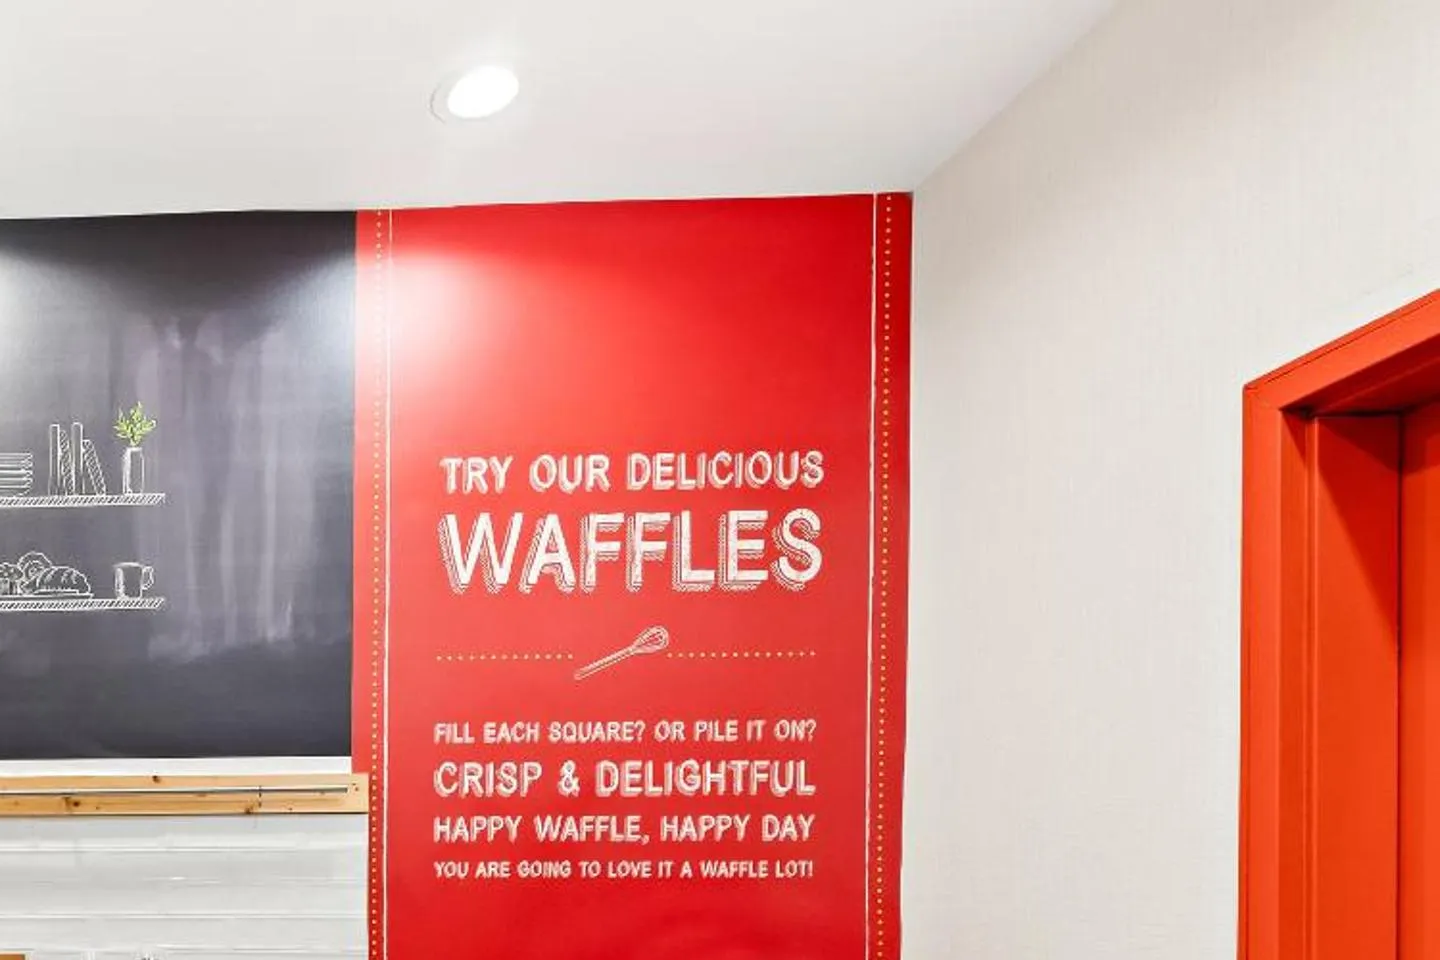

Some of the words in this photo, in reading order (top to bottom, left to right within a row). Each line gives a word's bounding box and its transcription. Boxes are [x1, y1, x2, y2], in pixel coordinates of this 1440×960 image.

[440, 455, 514, 495] TRY
[529, 453, 611, 494] OUR
[627, 449, 825, 490] DELICIOUS
[437, 508, 823, 593] WAFFLES
[434, 722, 475, 744] FILL
[483, 721, 539, 744] EACH
[548, 721, 646, 743] SQUARE?
[654, 720, 685, 741] OR
[693, 720, 738, 742] PILE
[746, 719, 764, 740] IT
[774, 719, 817, 740] ON?
[434, 760, 543, 797] CRISP
[558, 760, 580, 797] &
[596, 759, 816, 796] DELIGHTFUL
[433, 816, 522, 843] HAPPY
[534, 815, 650, 845] WAFFLE,
[660, 814, 751, 842] HAPPY
[761, 814, 816, 841] DAY
[434, 861, 468, 879] YOU
[475, 861, 511, 878] ARE
[518, 860, 571, 878] GOING
[579, 861, 601, 878] TO
[608, 861, 652, 878] LOVE
[658, 861, 672, 878] IT
[681, 861, 692, 878] A
[699, 860, 768, 878] WAFFLE
[775, 860, 813, 878] LOT!
